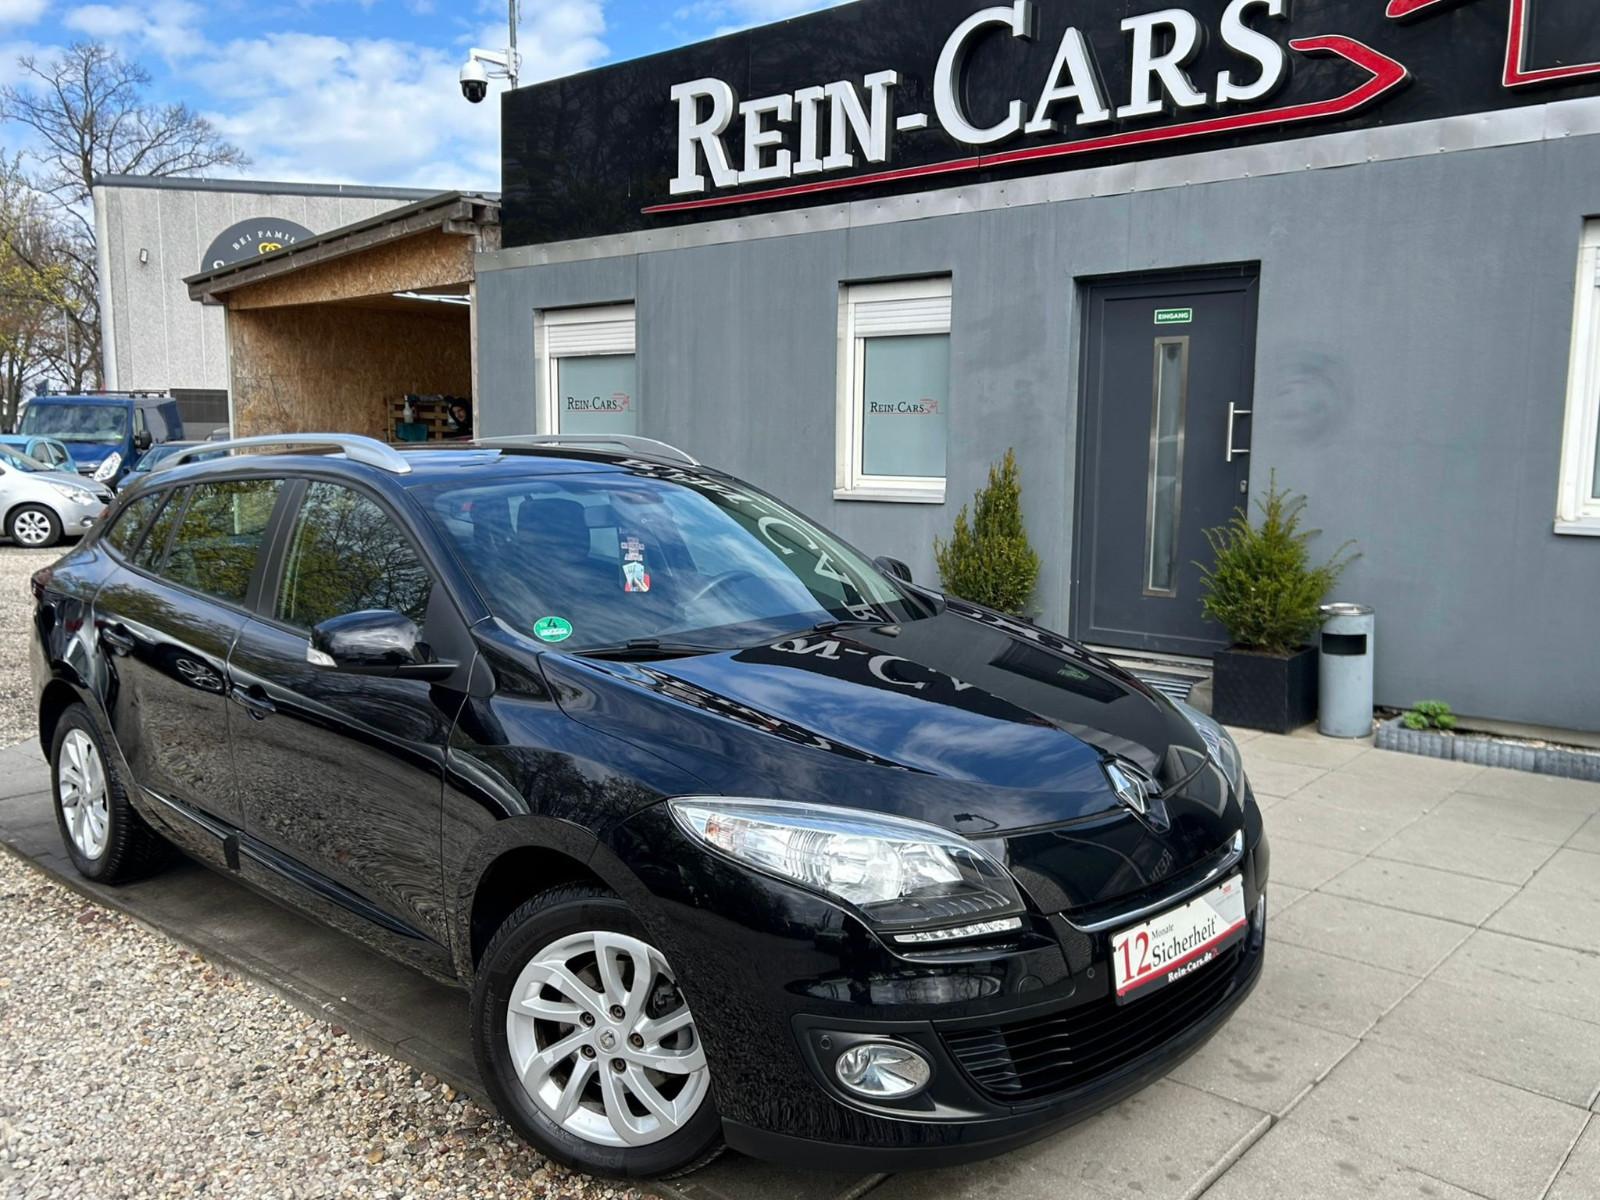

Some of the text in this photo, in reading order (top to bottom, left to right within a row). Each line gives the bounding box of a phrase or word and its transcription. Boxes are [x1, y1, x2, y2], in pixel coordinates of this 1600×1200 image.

[668, 0, 1287, 195] REIN-CARS
[1157, 312, 1189, 320] EINGANG
[567, 396, 617, 410] REIN-CARS
[870, 401, 924, 413] REIN-CARS
[1117, 931, 1151, 984] 12
[1167, 952, 1213, 983] Rein-Cars.de
